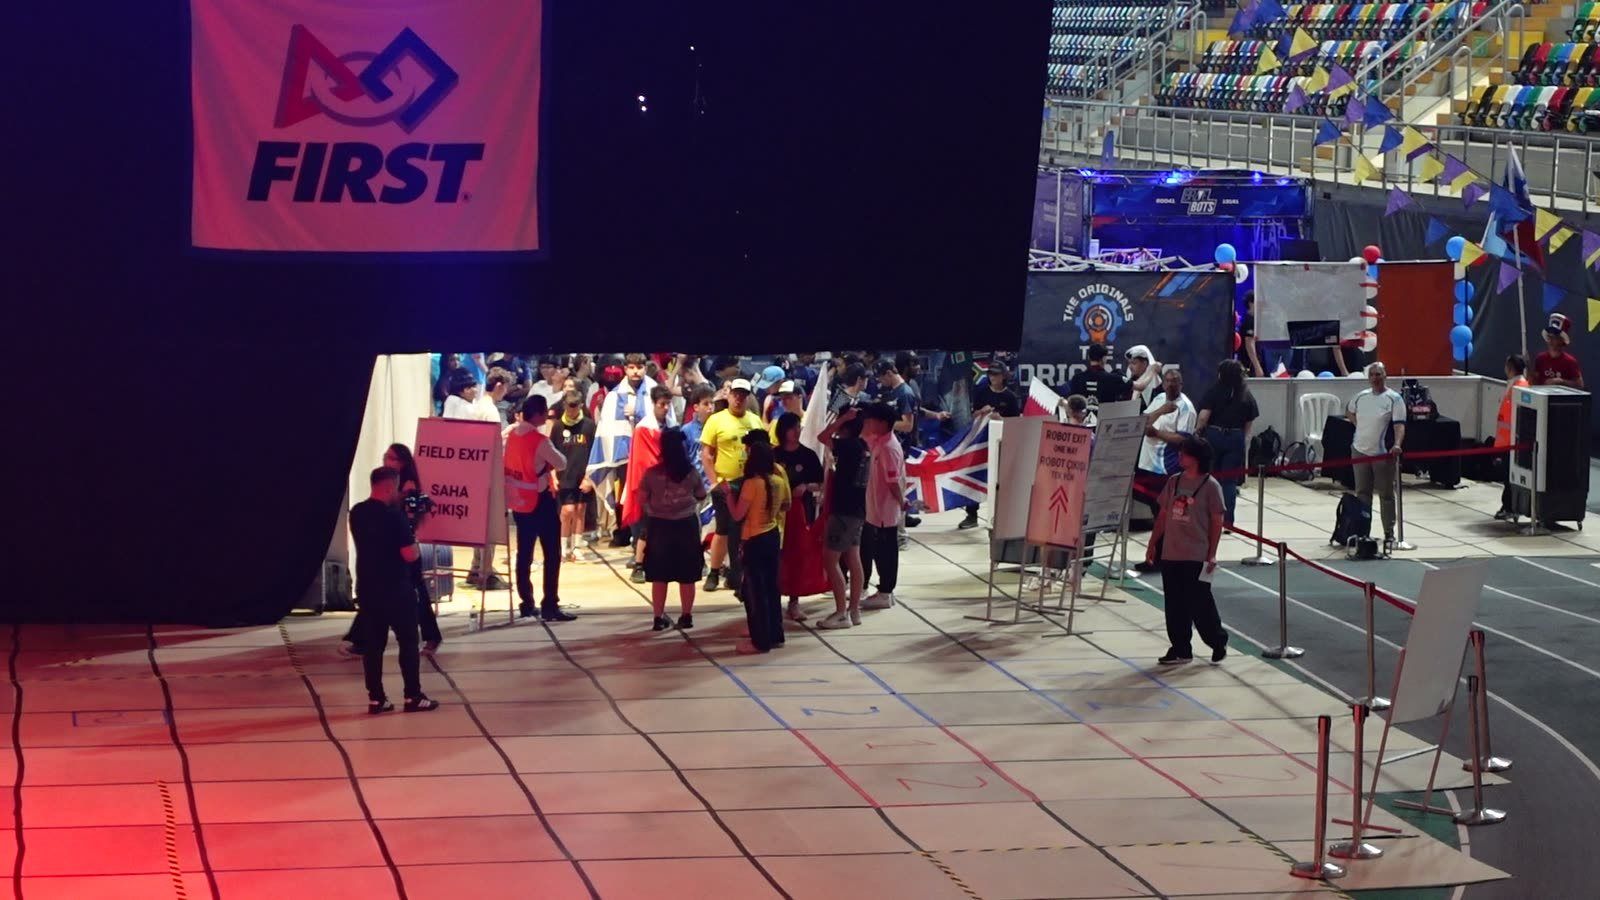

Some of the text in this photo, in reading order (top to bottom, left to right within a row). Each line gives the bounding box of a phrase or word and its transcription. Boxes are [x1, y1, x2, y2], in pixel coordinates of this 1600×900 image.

[247, 141, 485, 204] FIRST
[1190, 201, 1215, 212] BOTS
[1063, 283, 1134, 322] THE ORIGINALS
[1046, 430, 1087, 444] ROBOT EXIT
[418, 445, 489, 461] FIELD EXIT
[1053, 444, 1078, 454] ONE WAY
[1040, 456, 1066, 467] ROBOT
[431, 483, 469, 498] SAHA
[429, 503, 468, 520] ÇIKIŞI
